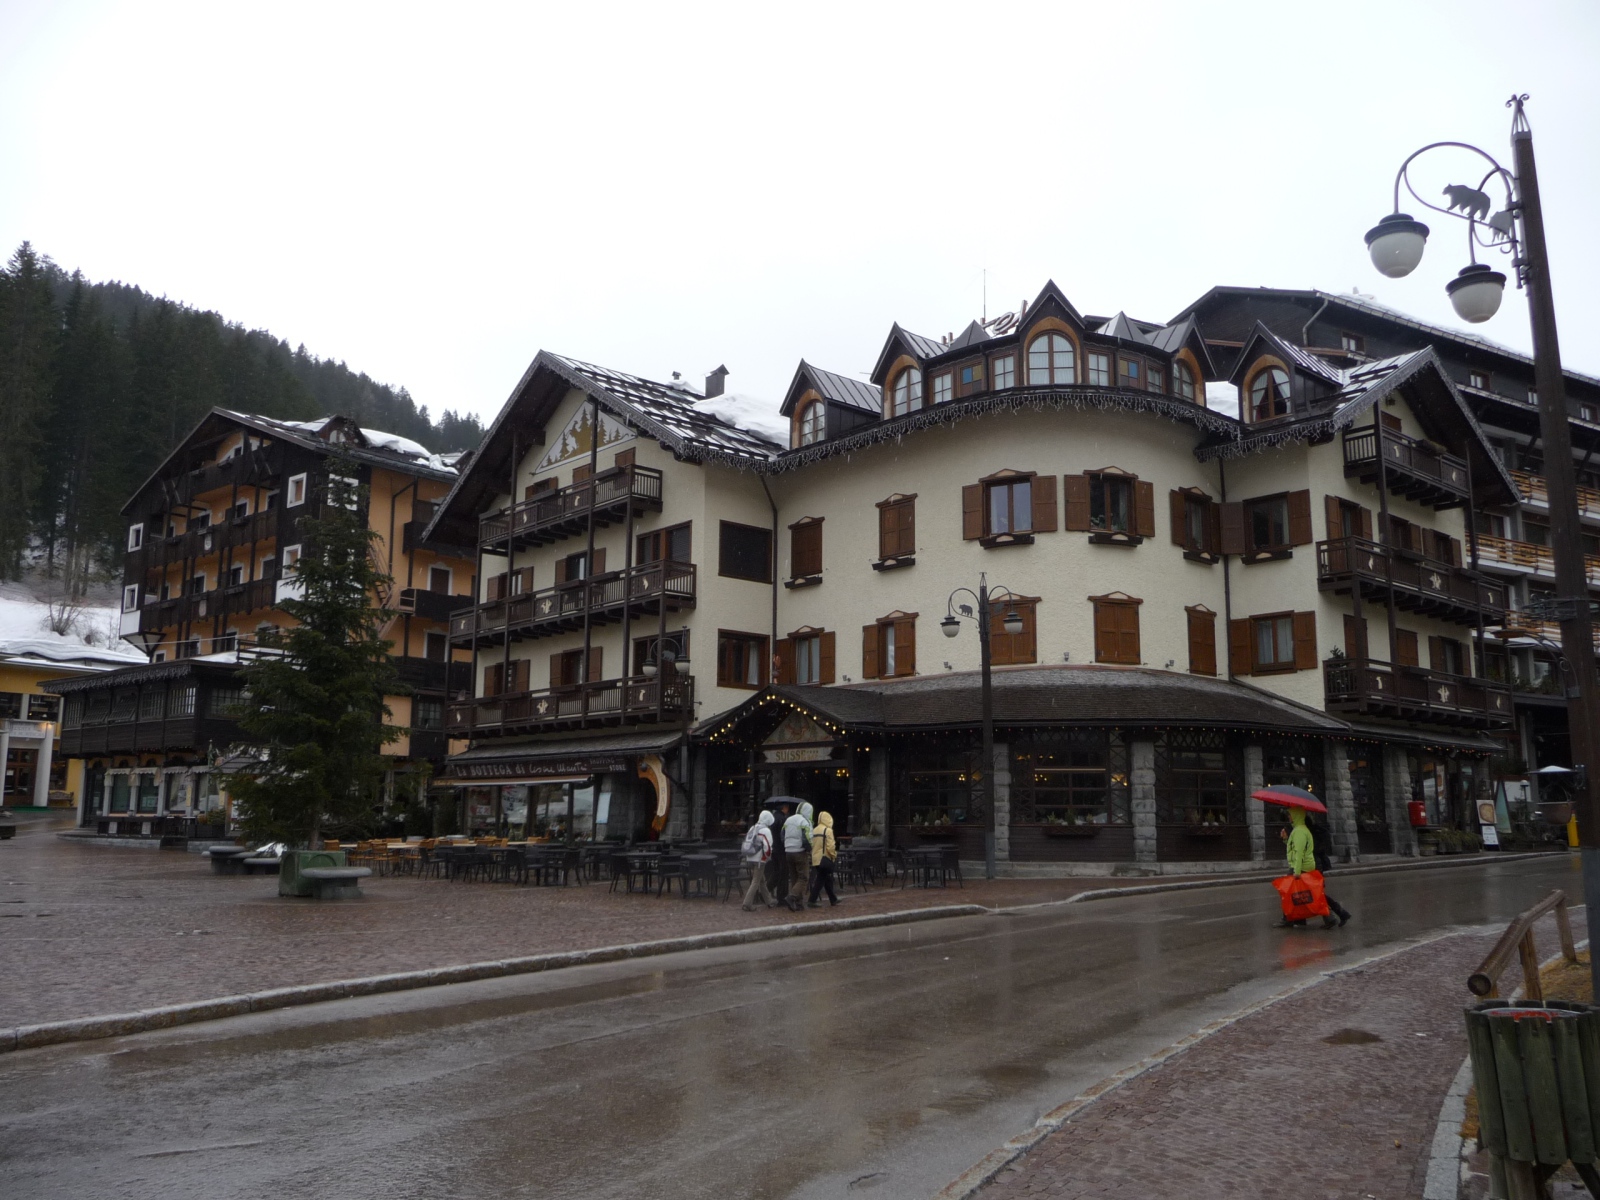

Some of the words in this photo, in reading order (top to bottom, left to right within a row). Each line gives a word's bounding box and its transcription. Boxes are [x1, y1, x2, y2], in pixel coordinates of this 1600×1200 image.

[775, 749, 806, 762] SUISSE
[470, 764, 512, 776] BOTTEGA
[515, 763, 526, 774] di
[608, 764, 627, 772] STORE
